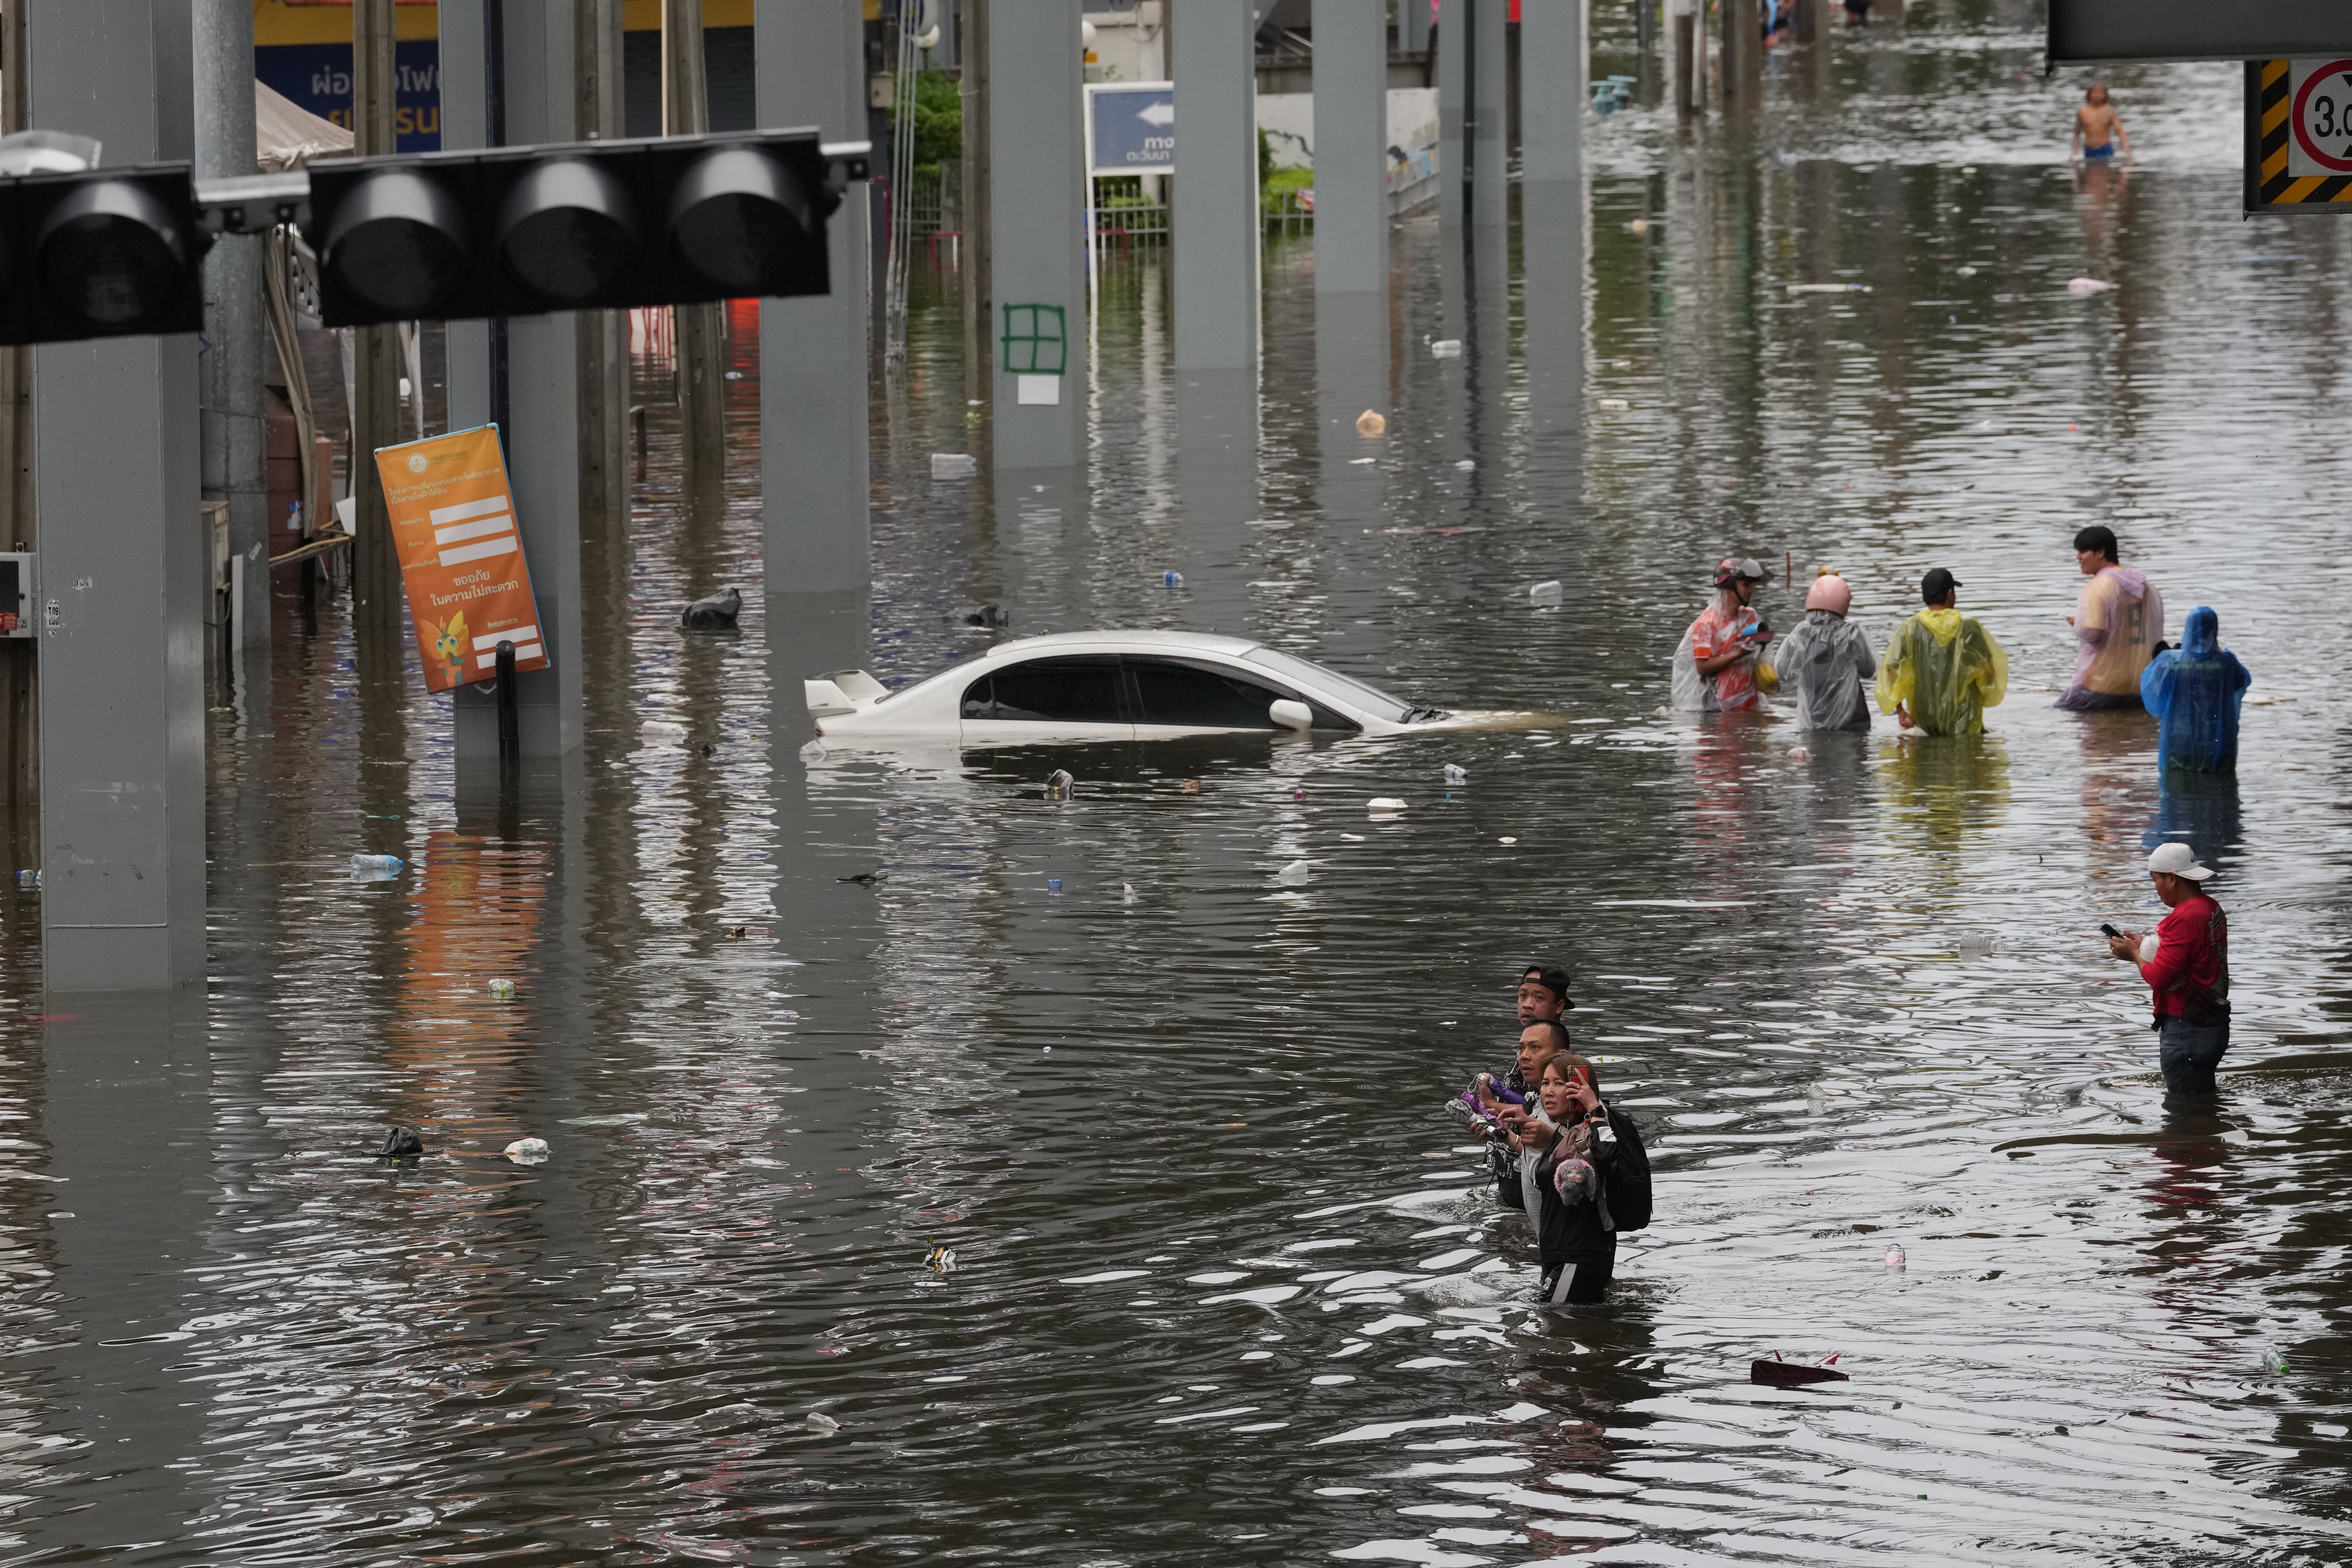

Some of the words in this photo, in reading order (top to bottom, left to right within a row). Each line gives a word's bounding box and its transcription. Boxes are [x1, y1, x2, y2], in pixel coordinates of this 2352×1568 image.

[453, 569, 490, 586] ขออภัย
[429, 580, 519, 606] ในความไม่สะดวก
